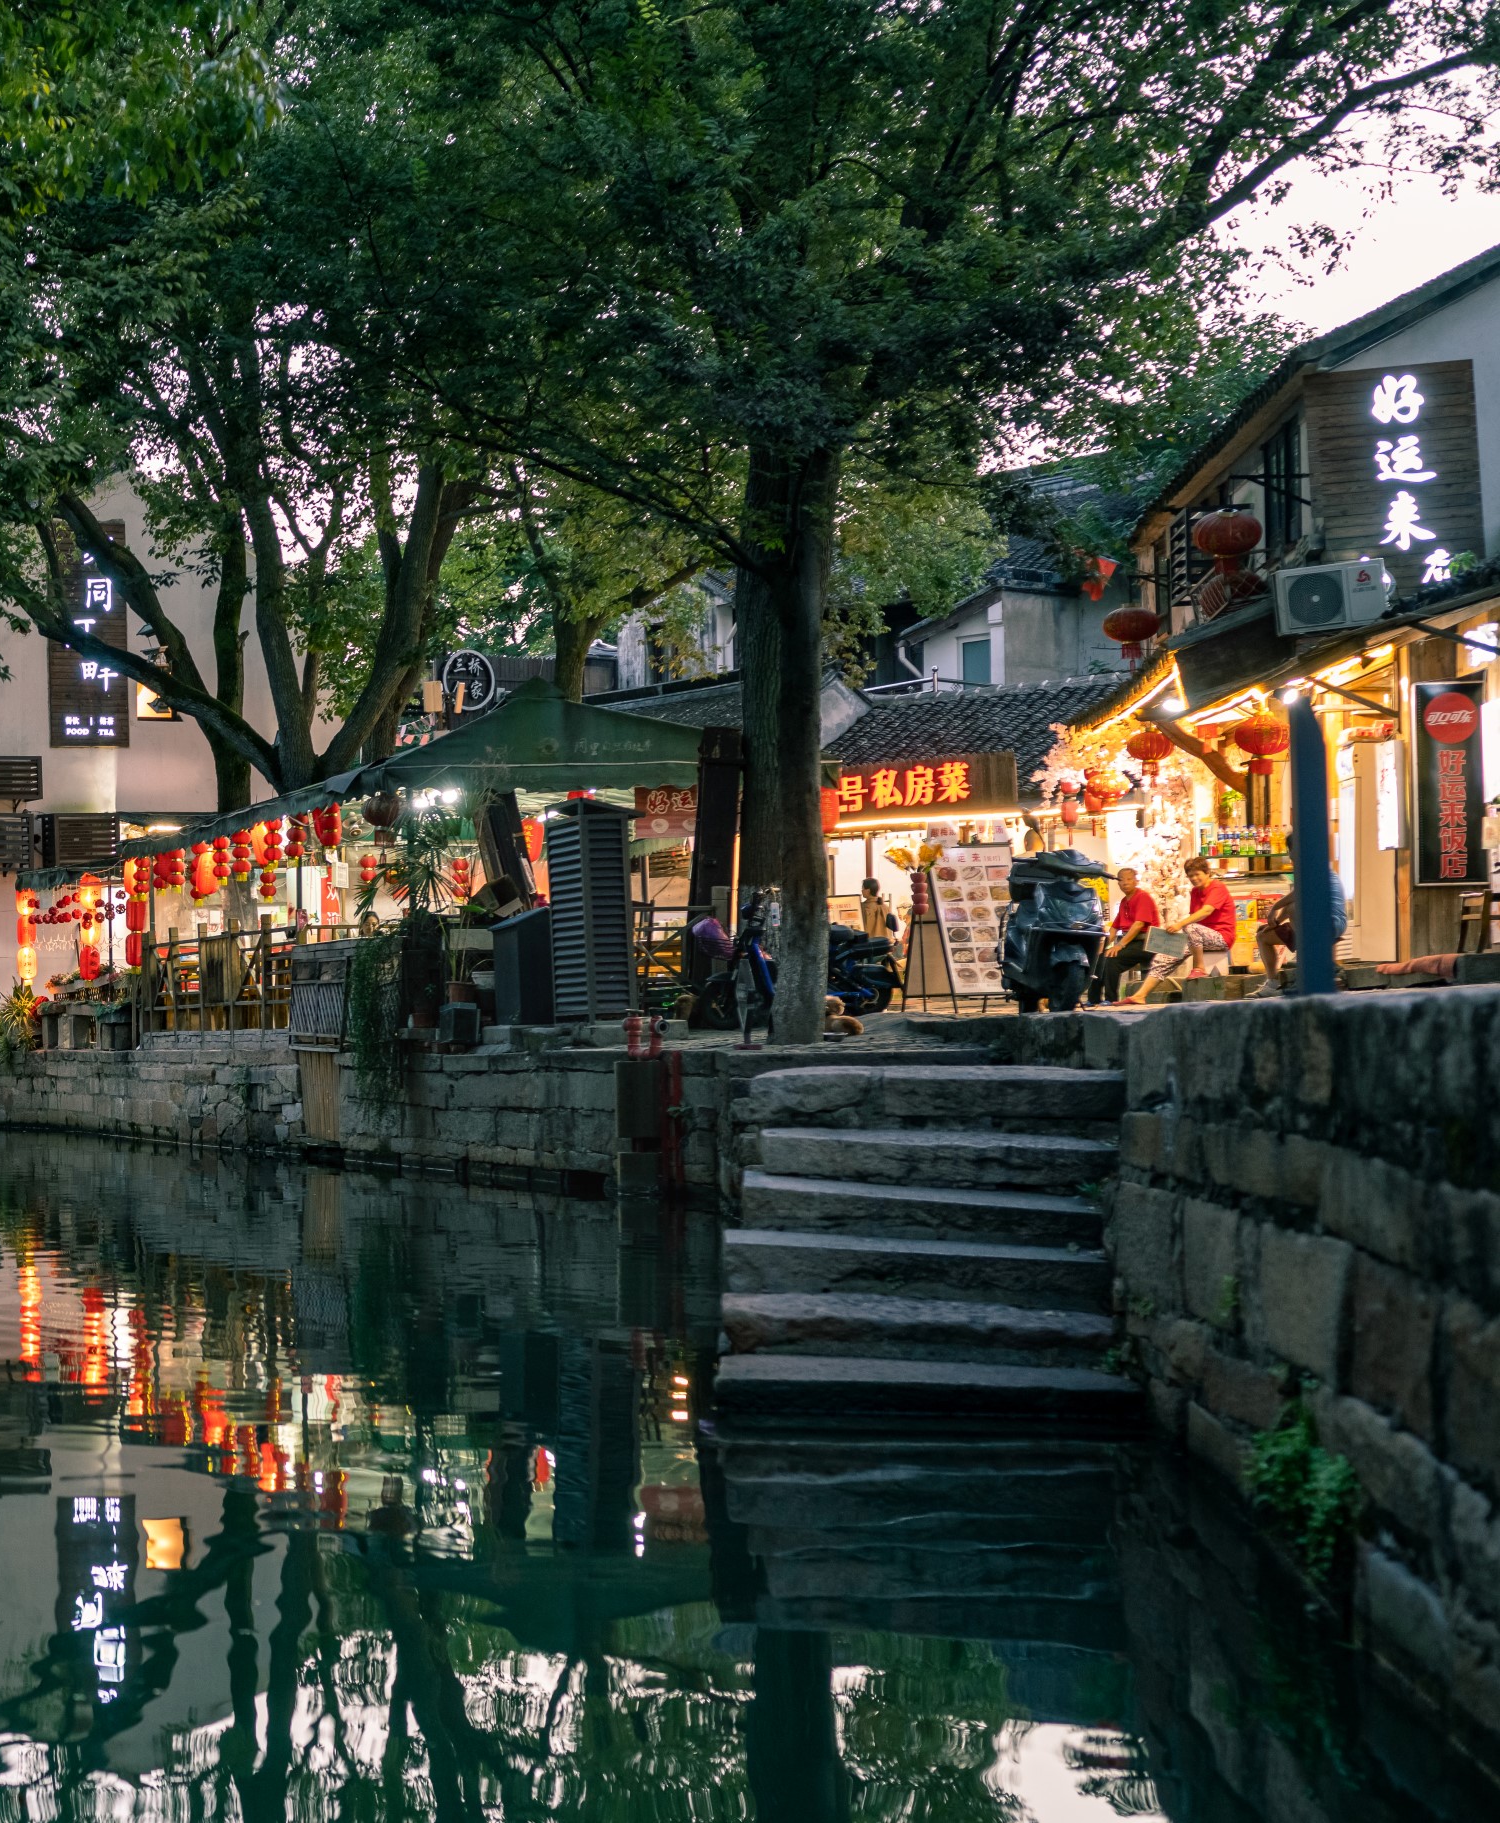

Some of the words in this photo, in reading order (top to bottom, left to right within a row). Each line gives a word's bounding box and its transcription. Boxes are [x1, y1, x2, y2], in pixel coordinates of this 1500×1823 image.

[453, 657, 484, 677] 三桥
[1426, 709, 1475, 726] 可口可乐
[66, 727, 90, 736] FOOD
[647, 790, 698, 815] 好运
[1438, 749, 1467, 879] 好运来饭店
